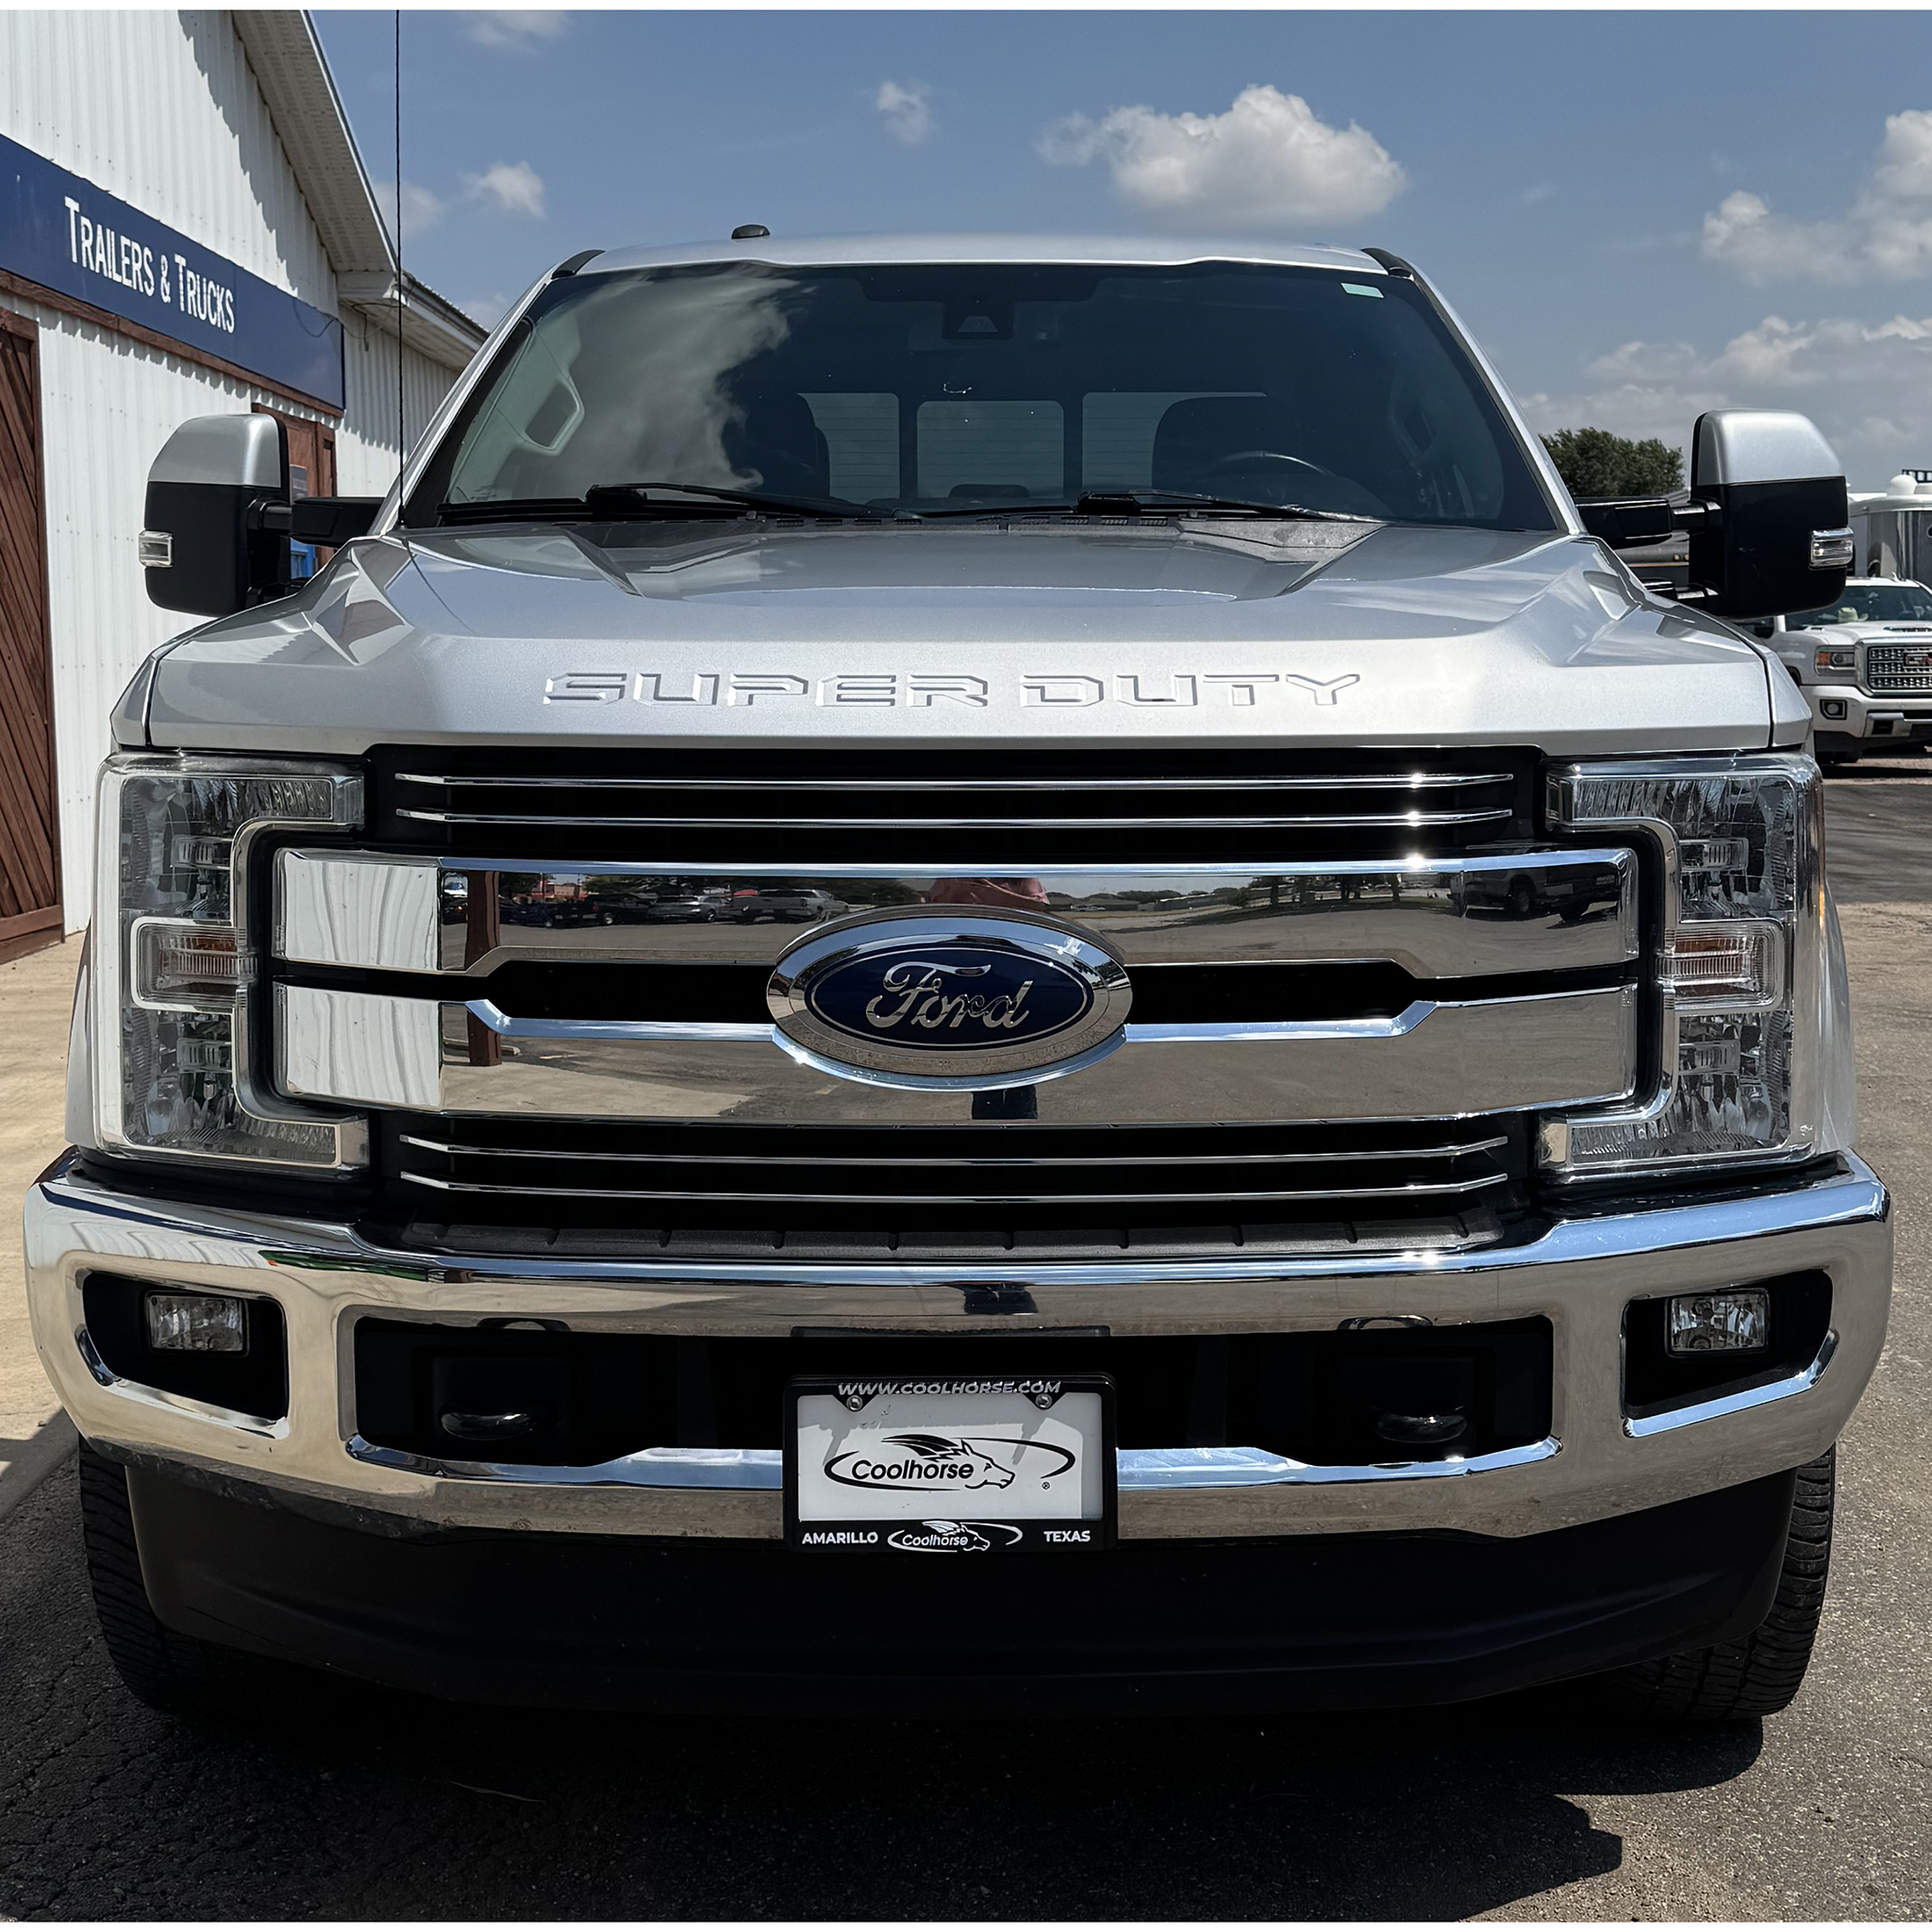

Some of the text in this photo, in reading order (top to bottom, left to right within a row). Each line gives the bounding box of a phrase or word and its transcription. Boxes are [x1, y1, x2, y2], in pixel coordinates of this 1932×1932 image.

[64, 195, 234, 333] TRAILERS & TRUCKS
[543, 673, 1360, 708] SUPER DUTY
[865, 961, 1034, 1028] Ford
[838, 1381, 1061, 1395] WWW.COOLHORSE.COM
[851, 1459, 974, 1479] Coolhorse
[802, 1530, 1091, 1548] AMARILLO Coolhorse TEXAS
